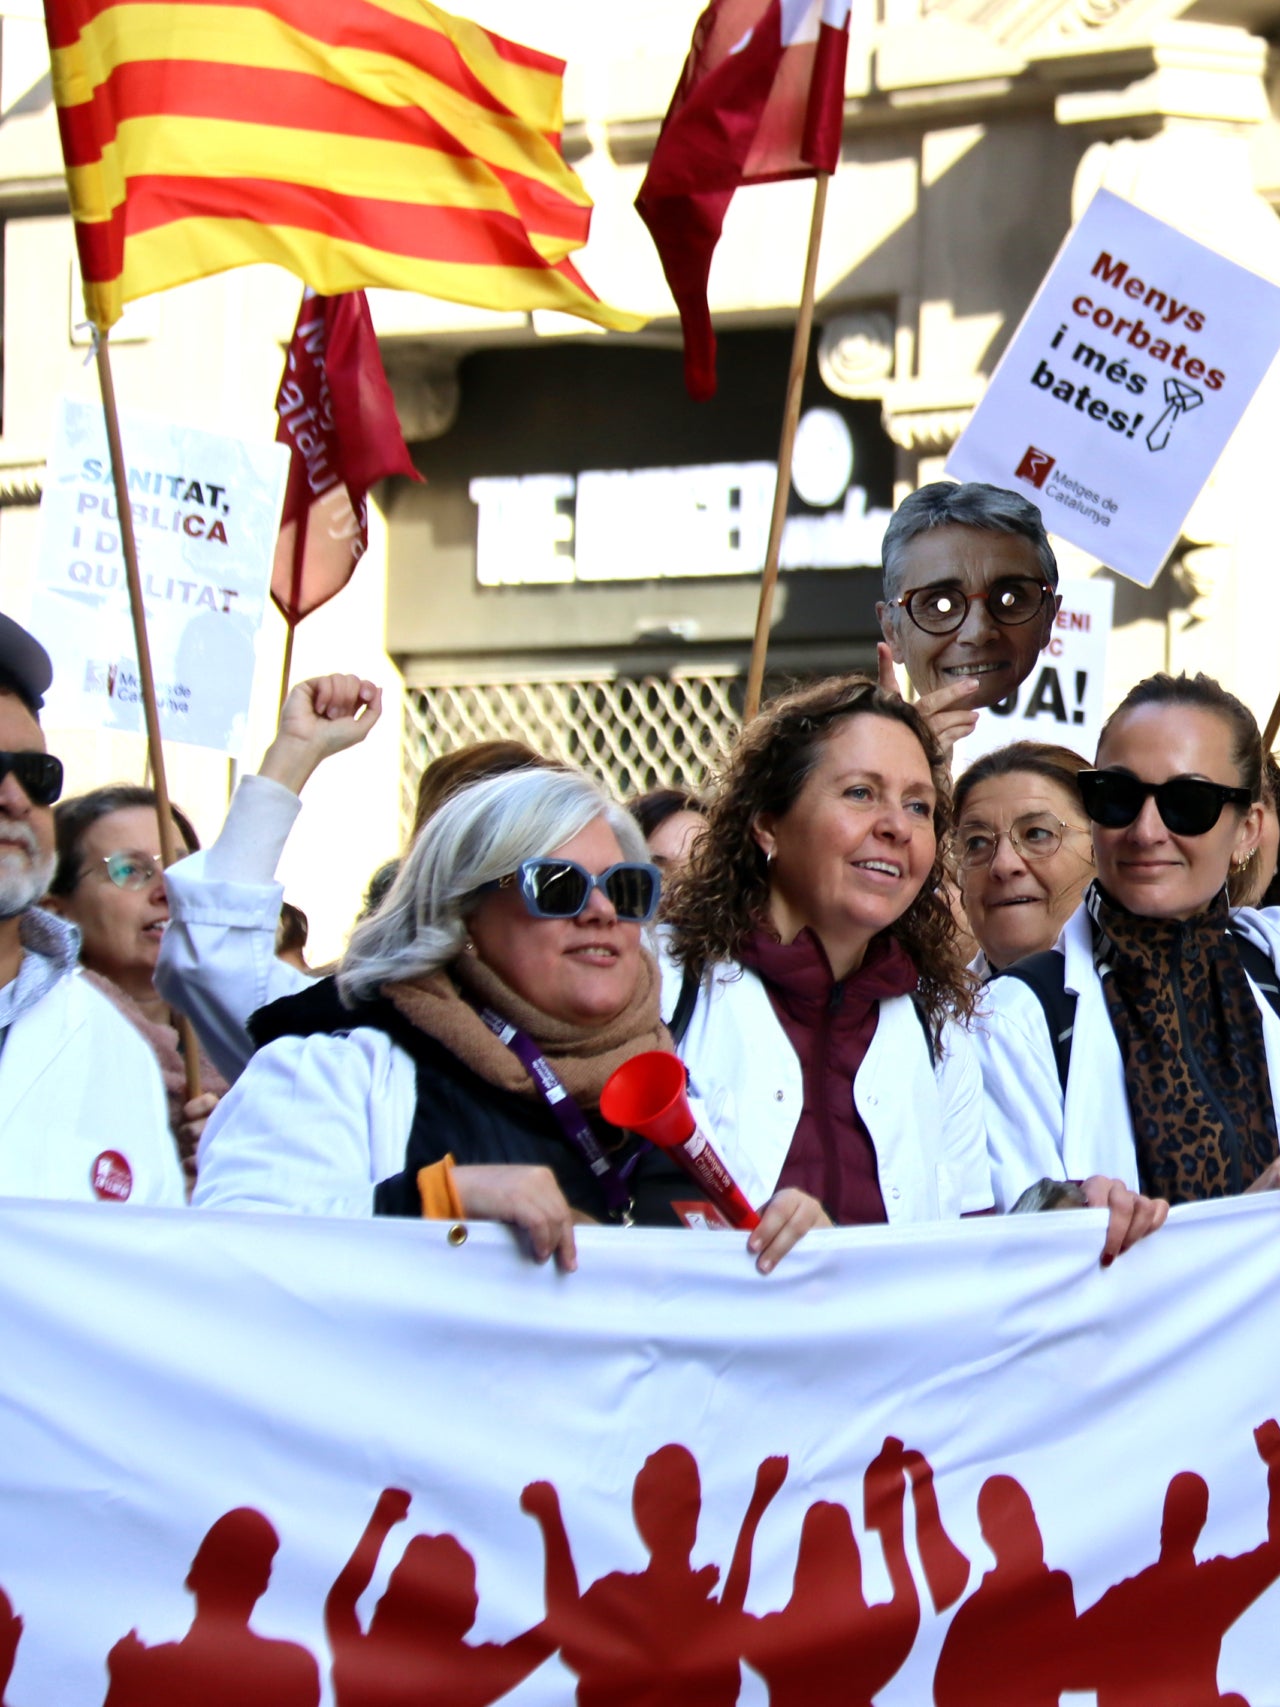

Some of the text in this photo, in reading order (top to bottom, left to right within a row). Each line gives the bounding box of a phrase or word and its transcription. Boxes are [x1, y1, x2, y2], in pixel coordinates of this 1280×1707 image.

[1091, 252, 1207, 333] Menys
[1050, 324, 1148, 395] i més
[1072, 295, 1226, 390] corbates
[1030, 360, 1144, 439] bates!
[81, 458, 230, 517] SNITAT,
[1045, 484, 1111, 527] Catalunya
[1052, 470, 1119, 513] Metges de
[67, 561, 239, 614] QULITAT
